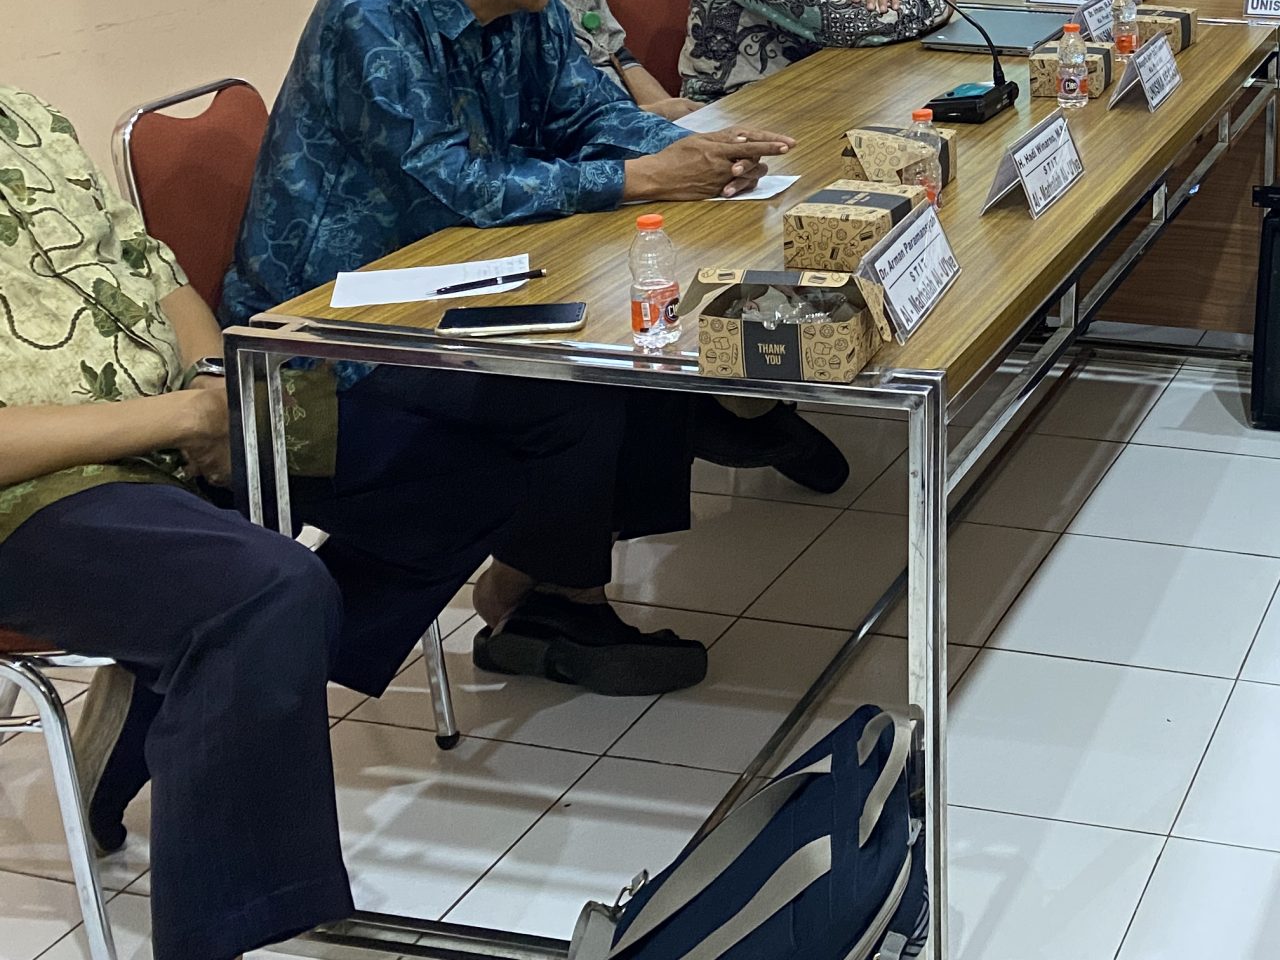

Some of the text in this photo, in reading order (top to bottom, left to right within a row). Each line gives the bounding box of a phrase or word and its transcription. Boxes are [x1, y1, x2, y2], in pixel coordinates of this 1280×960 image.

[1023, 148, 1037, 164] Hadi
[879, 268, 889, 280] Dr.
[887, 249, 906, 271] Arman
[908, 277, 938, 316] Marhalah
[757, 343, 786, 355] THANK
[765, 354, 781, 365] YOU
